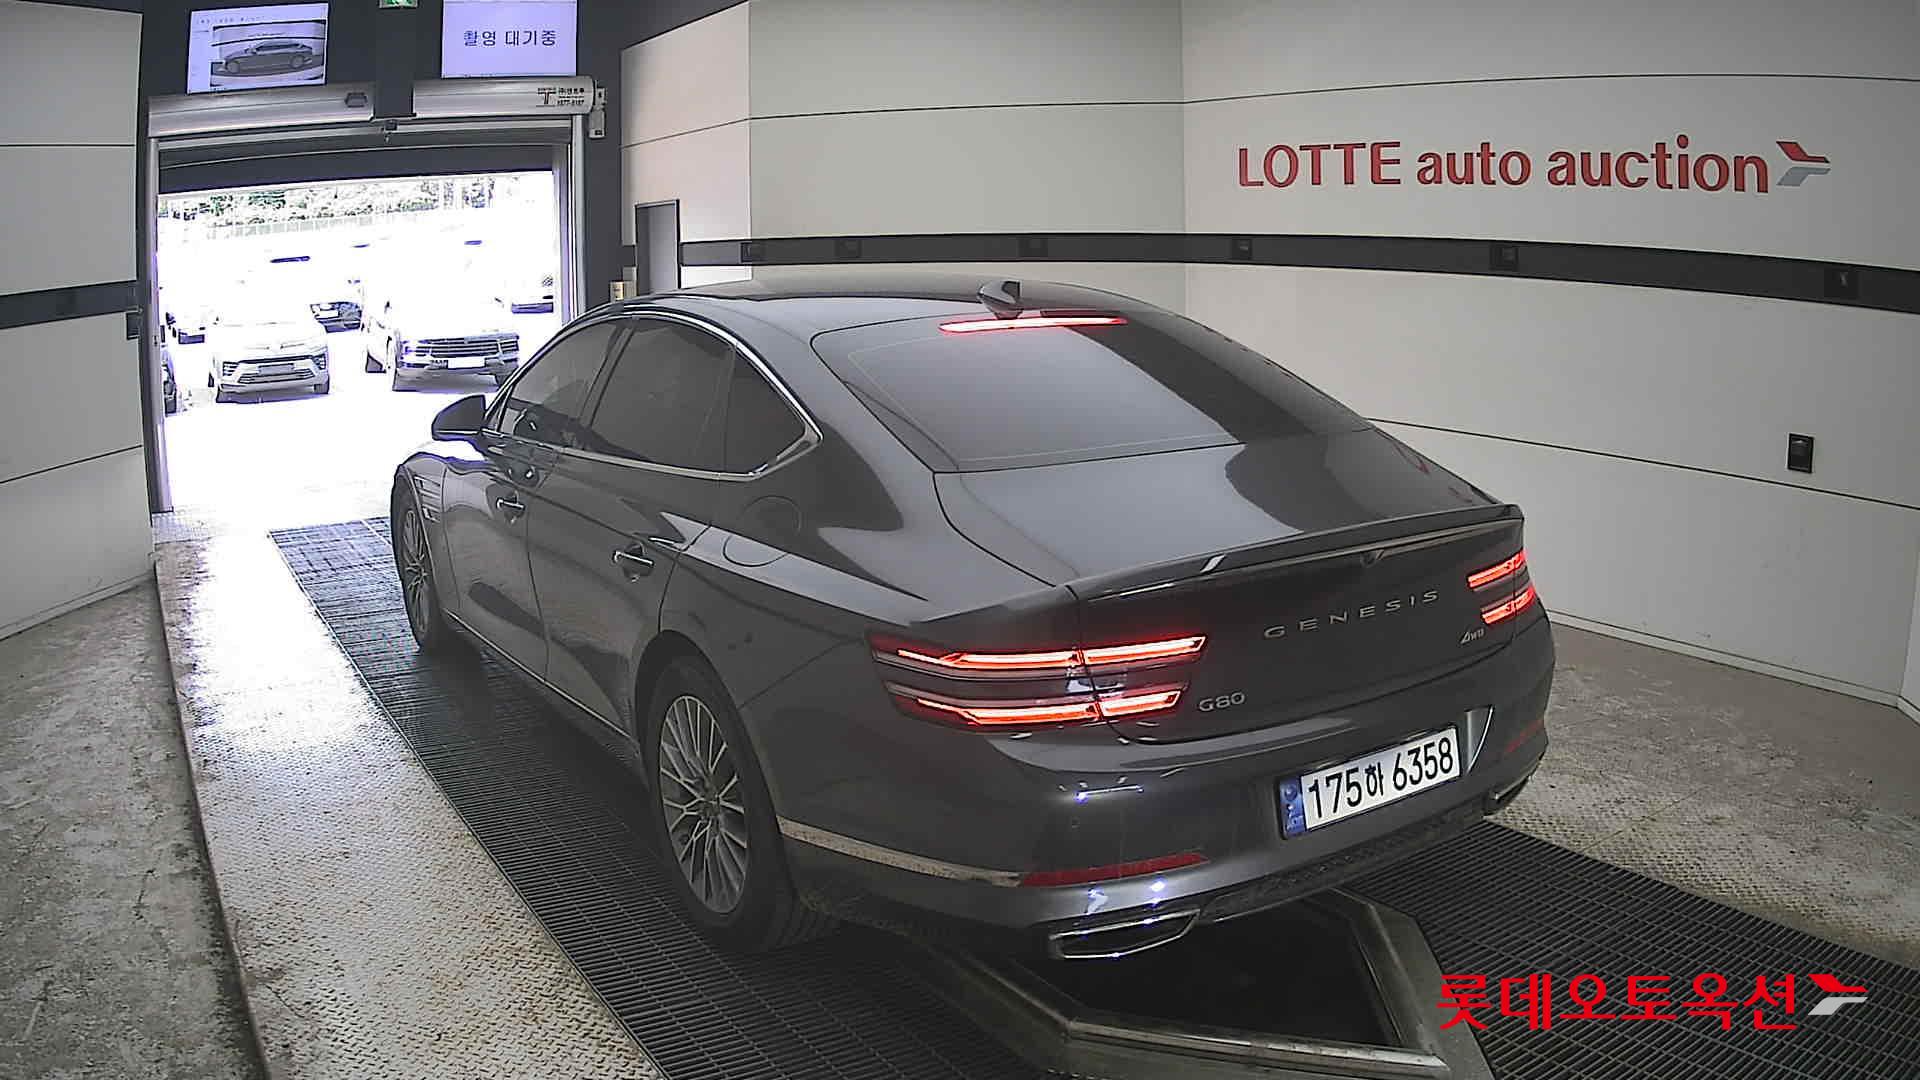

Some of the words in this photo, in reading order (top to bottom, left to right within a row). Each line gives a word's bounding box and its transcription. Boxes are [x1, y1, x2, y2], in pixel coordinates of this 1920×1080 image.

[463, 29, 497, 47] 촬영
[504, 29, 557, 47] 대기중
[1239, 141, 1401, 188] LOTTE
[1416, 142, 1532, 187] auto
[1546, 134, 1770, 194] auction
[1263, 589, 1439, 640] GENESIS
[1197, 691, 1246, 713] G80
[1308, 761, 1385, 819] 175하
[1392, 736, 1454, 792] 6358
